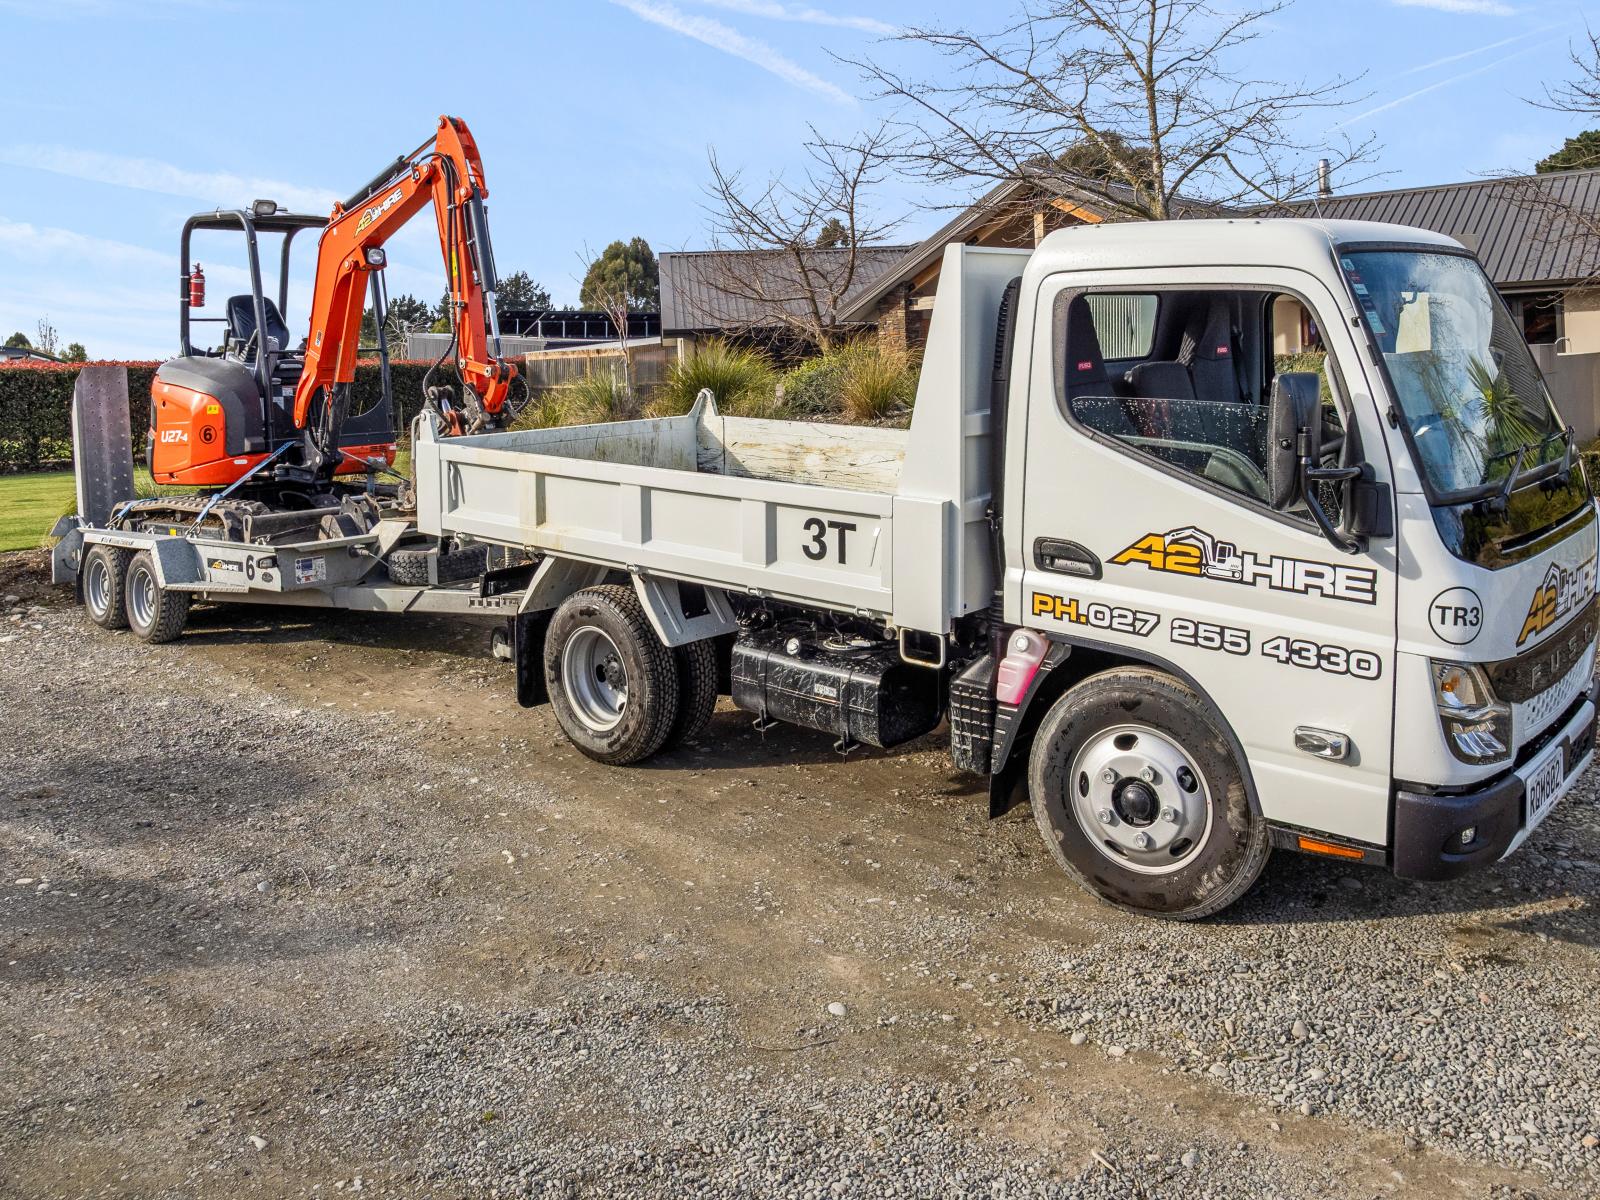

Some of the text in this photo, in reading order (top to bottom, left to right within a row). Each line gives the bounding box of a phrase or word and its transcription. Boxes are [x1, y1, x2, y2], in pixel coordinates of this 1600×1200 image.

[161, 430, 188, 443] U27-4
[203, 427, 213, 442] 6
[802, 517, 857, 565] 3T
[246, 555, 255, 580] 6
[1105, 532, 1377, 605] A2 HIRE
[1435, 605, 1480, 627] TR3
[1516, 585, 1557, 648] A2
[1170, 618, 1250, 655] 255
[1261, 636, 1382, 681] 4330
